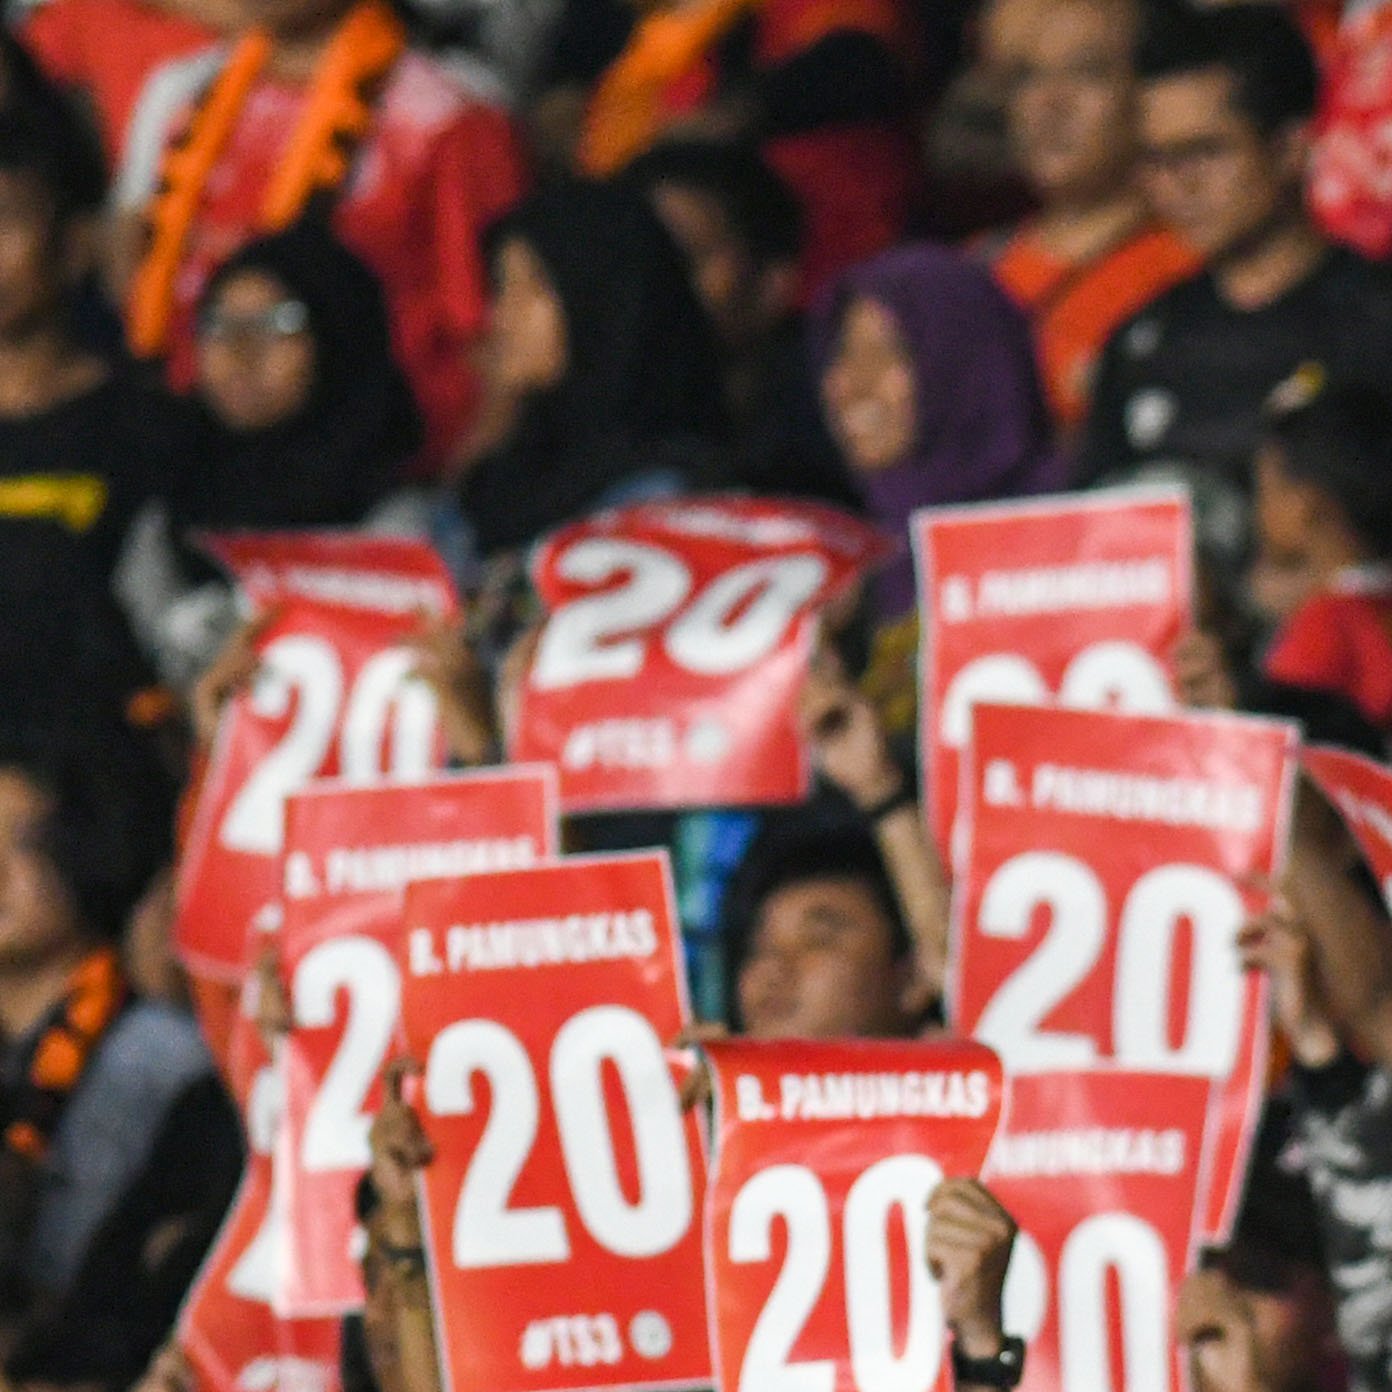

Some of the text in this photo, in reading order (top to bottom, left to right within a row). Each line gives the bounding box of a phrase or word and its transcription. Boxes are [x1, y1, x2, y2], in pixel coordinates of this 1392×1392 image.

[532, 538, 828, 692] 20
[219, 634, 441, 856] 20
[974, 850, 1248, 1078] 20
[425, 1004, 695, 1270] 20
[735, 1071, 990, 1121] B. PAMUNGKAS
